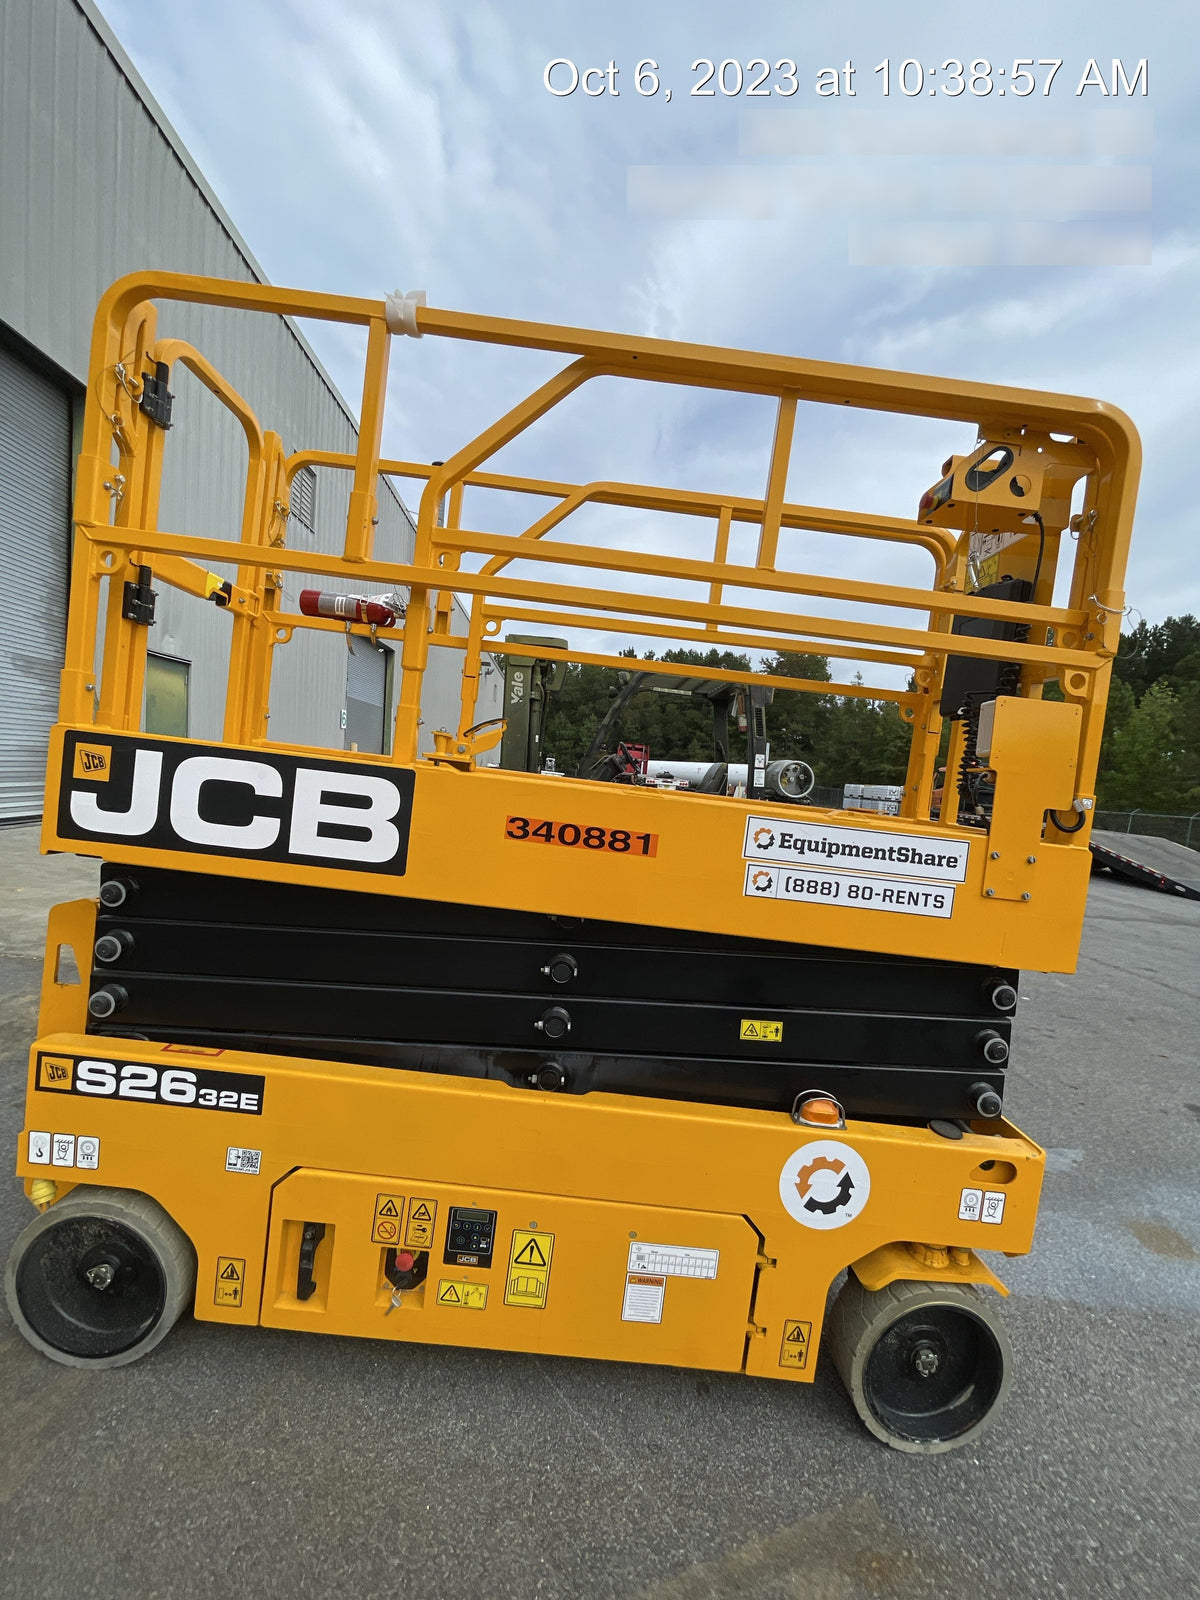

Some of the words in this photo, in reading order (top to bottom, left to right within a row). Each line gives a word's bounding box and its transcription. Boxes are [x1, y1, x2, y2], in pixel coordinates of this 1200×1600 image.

[511, 673, 523, 704] Yale
[83, 751, 106, 771] JCB
[70, 750, 401, 863] JCB
[507, 816, 653, 855] 340881
[778, 832, 959, 869] EquipmentShare
[784, 876, 841, 898] (888)
[847, 886, 946, 909] 80-RENTS
[48, 1065, 68, 1080] JCB
[458, 1255, 477, 1263] JCB
[637, 1277, 662, 1286] WARNING
